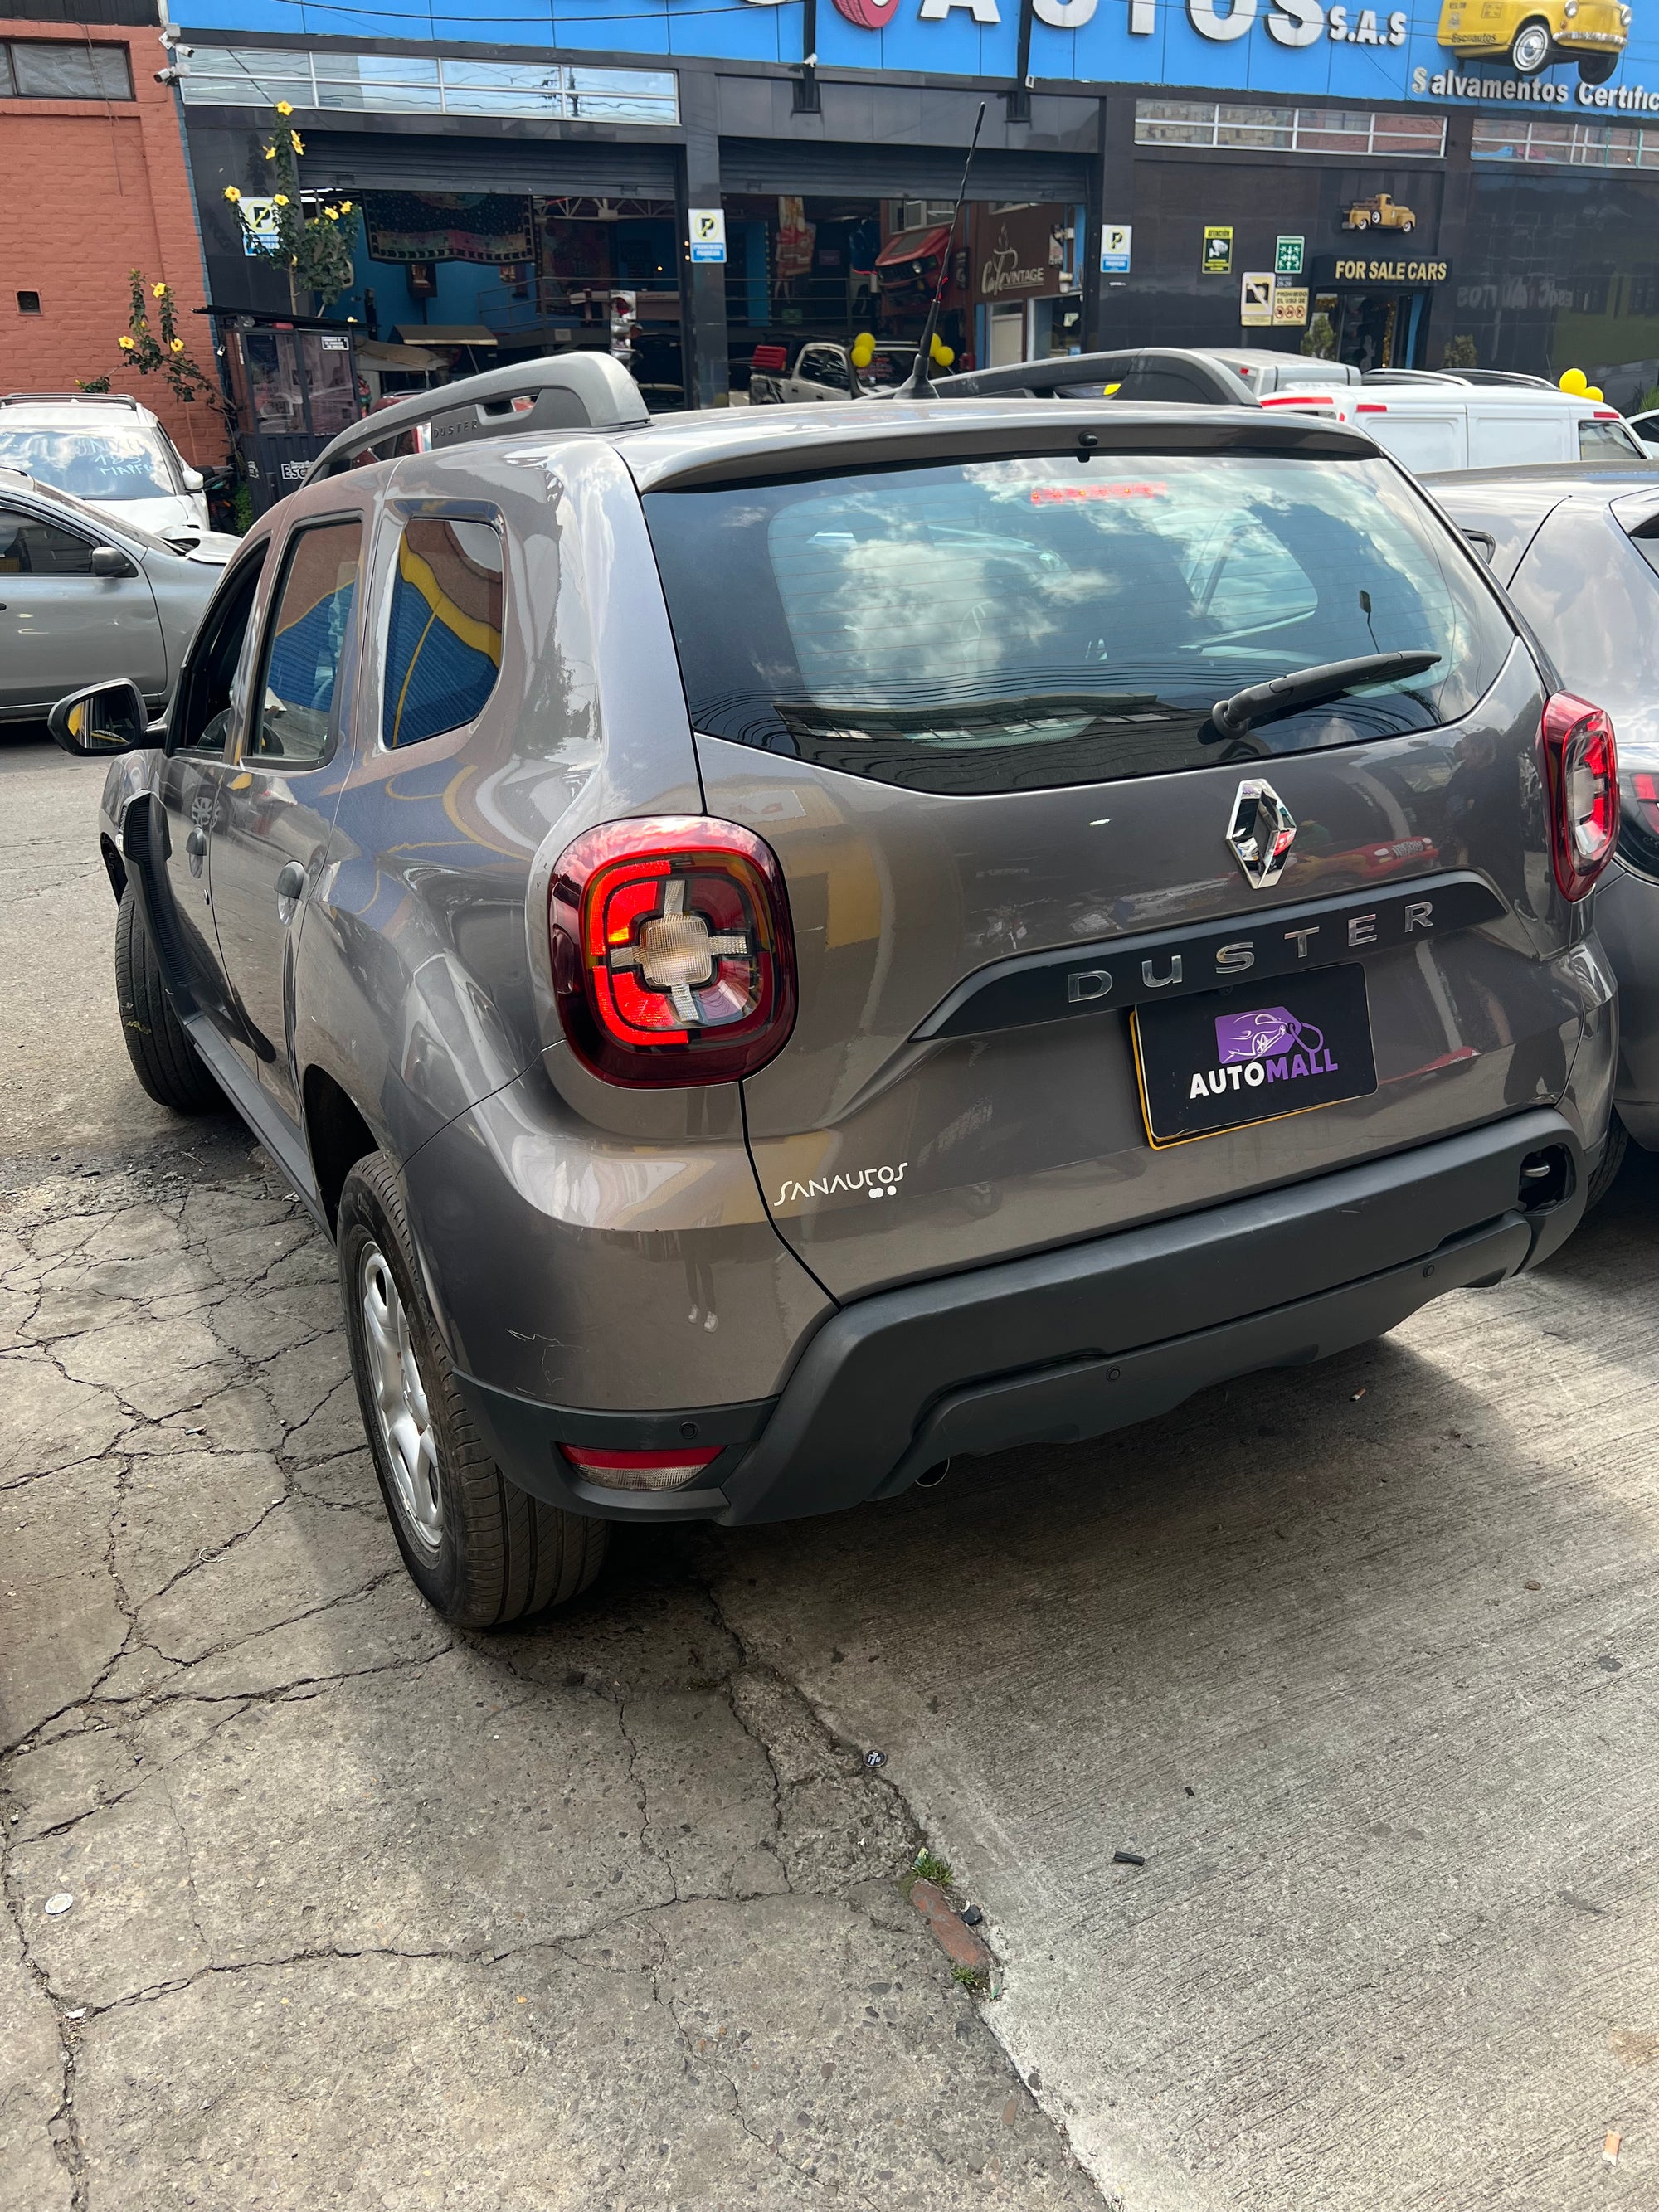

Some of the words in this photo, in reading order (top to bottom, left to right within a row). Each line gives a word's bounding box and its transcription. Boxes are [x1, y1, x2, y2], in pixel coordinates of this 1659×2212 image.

[1335, 260, 1367, 280] FOR
[1369, 260, 1407, 280] SALE
[1407, 261, 1447, 280] CARS
[433, 419, 478, 438] DUSTER
[1068, 901, 1433, 1004] DUSTER
[1189, 1048, 1339, 1100] AUTOMALL
[773, 1162, 909, 1207] SANAUTOS
